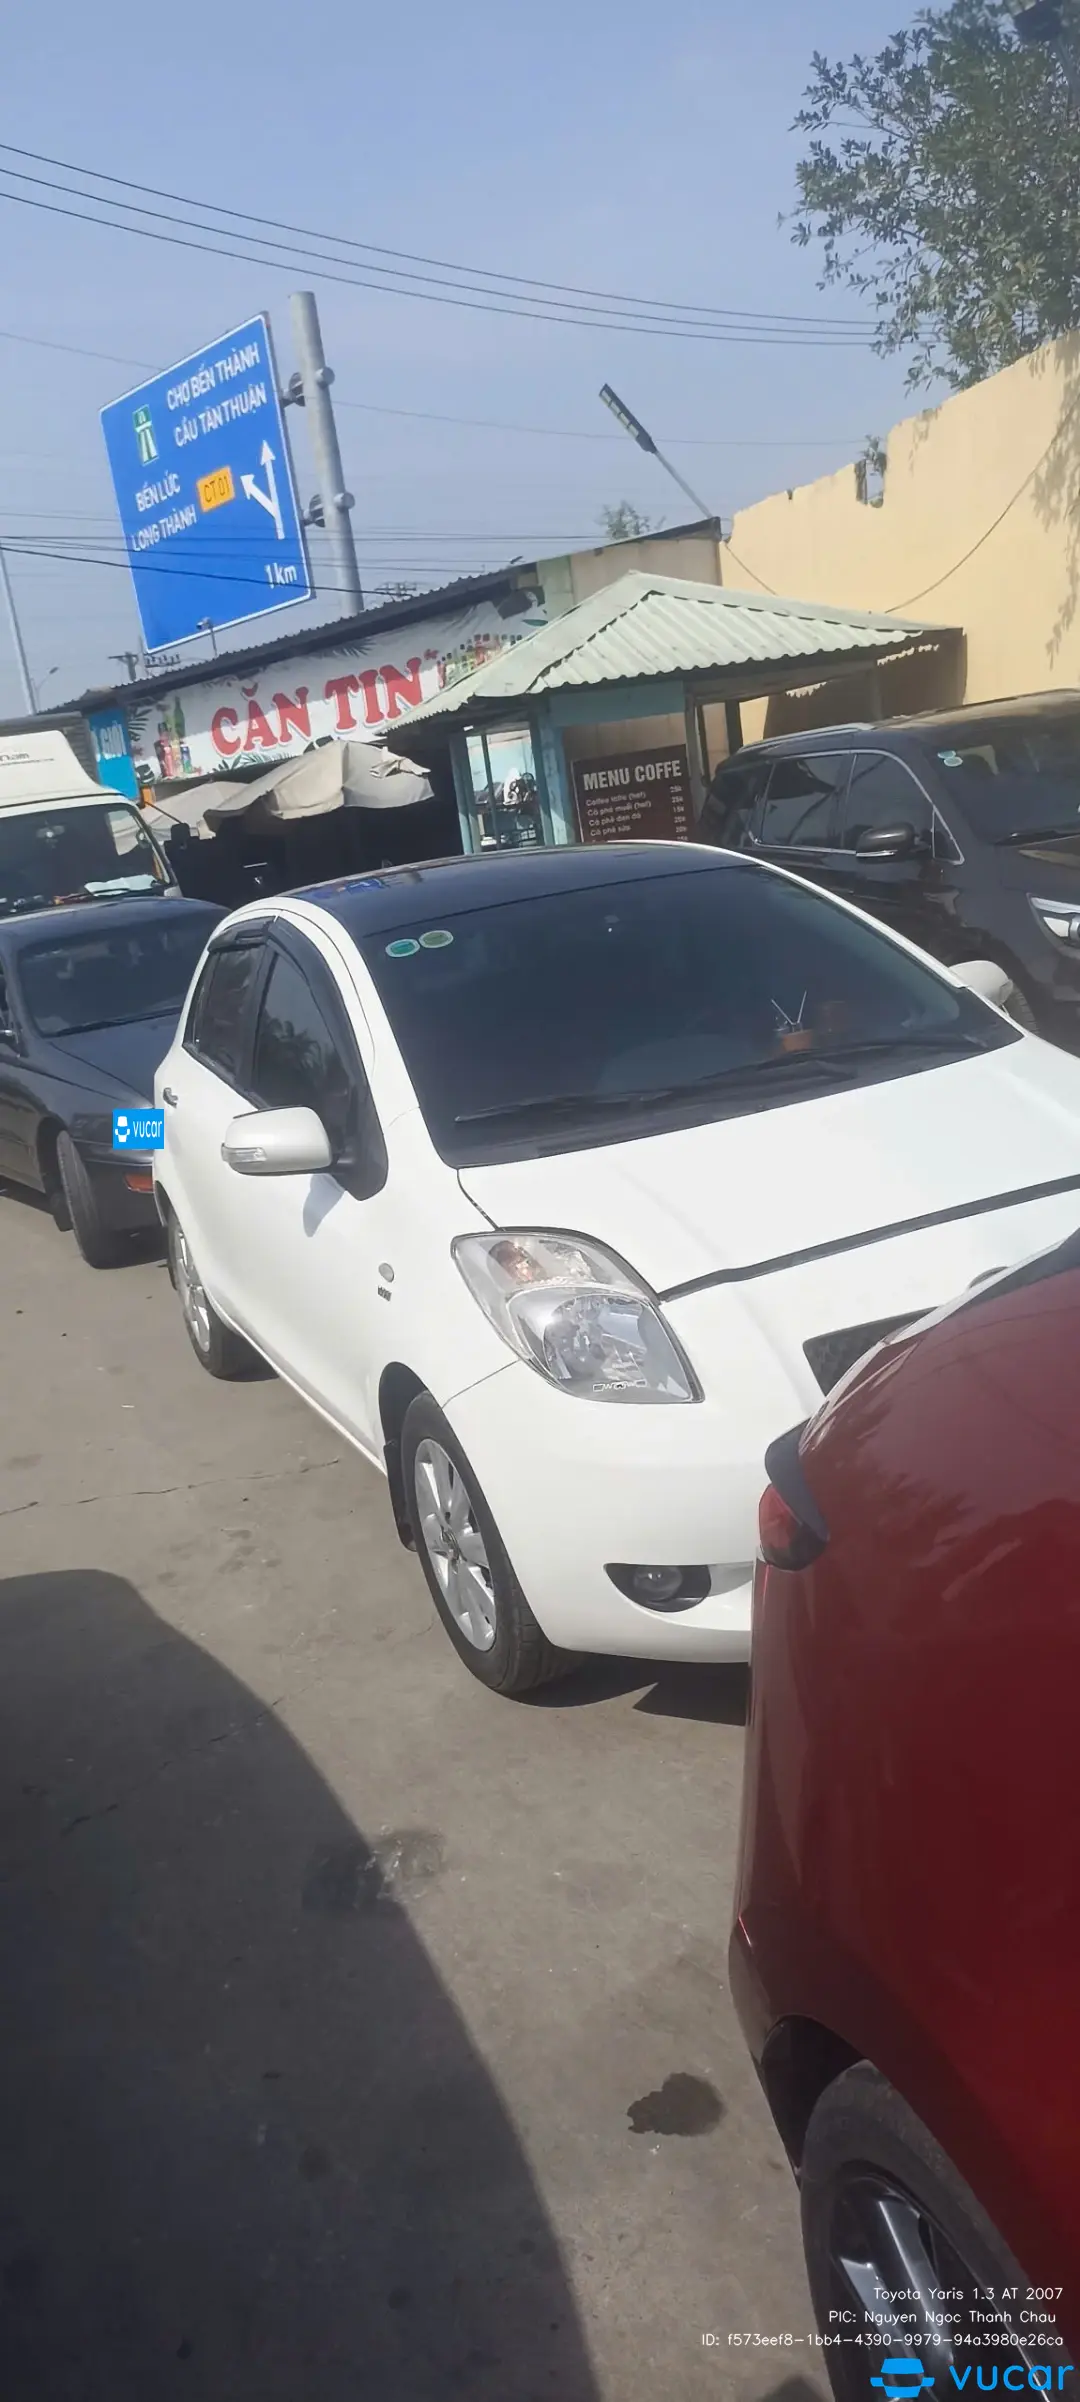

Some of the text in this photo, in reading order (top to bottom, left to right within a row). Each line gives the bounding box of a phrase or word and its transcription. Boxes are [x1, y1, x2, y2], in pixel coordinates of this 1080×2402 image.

[167, 341, 260, 410] CHỢ BẾN THÀNH
[198, 405, 223, 434] TÂN
[221, 382, 267, 422] THUẬN
[135, 469, 181, 512] BẾN LÚC
[132, 503, 197, 551] LONG THÀNH
[264, 562, 297, 589] 1 km
[211, 682, 312, 757] CĂN
[324, 656, 424, 731] TIN
[583, 760, 682, 790] MENU COFFE
